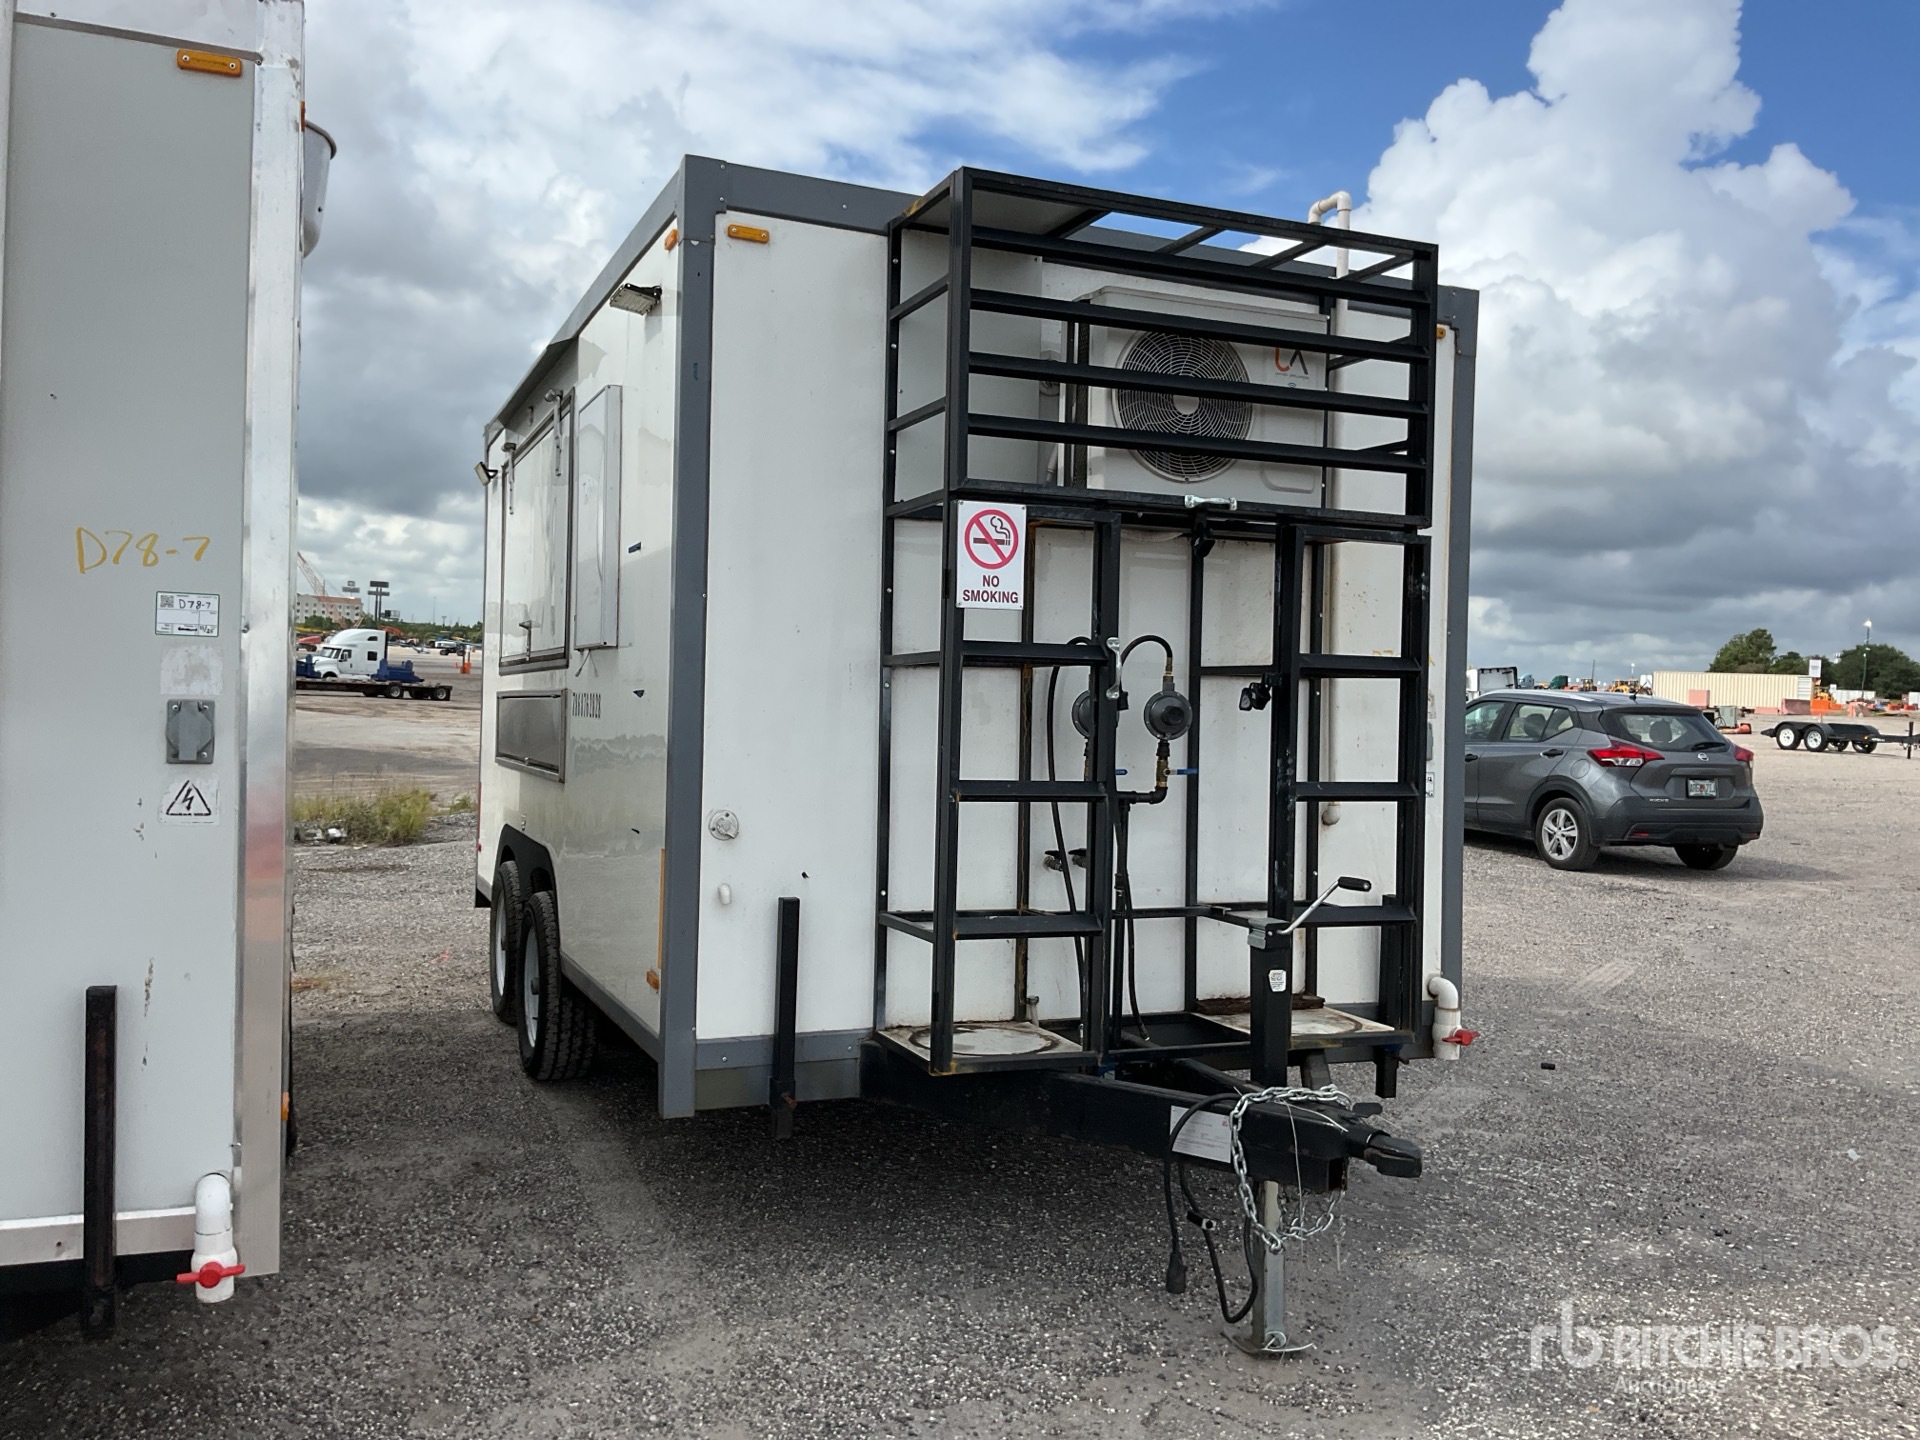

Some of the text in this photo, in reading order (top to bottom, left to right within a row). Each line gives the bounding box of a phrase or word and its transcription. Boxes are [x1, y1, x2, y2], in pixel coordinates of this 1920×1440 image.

[75, 526, 211, 574] D78-7
[982, 574, 1000, 588] NO
[962, 589, 1019, 604] SMOKING
[178, 598, 211, 610] D78-7
